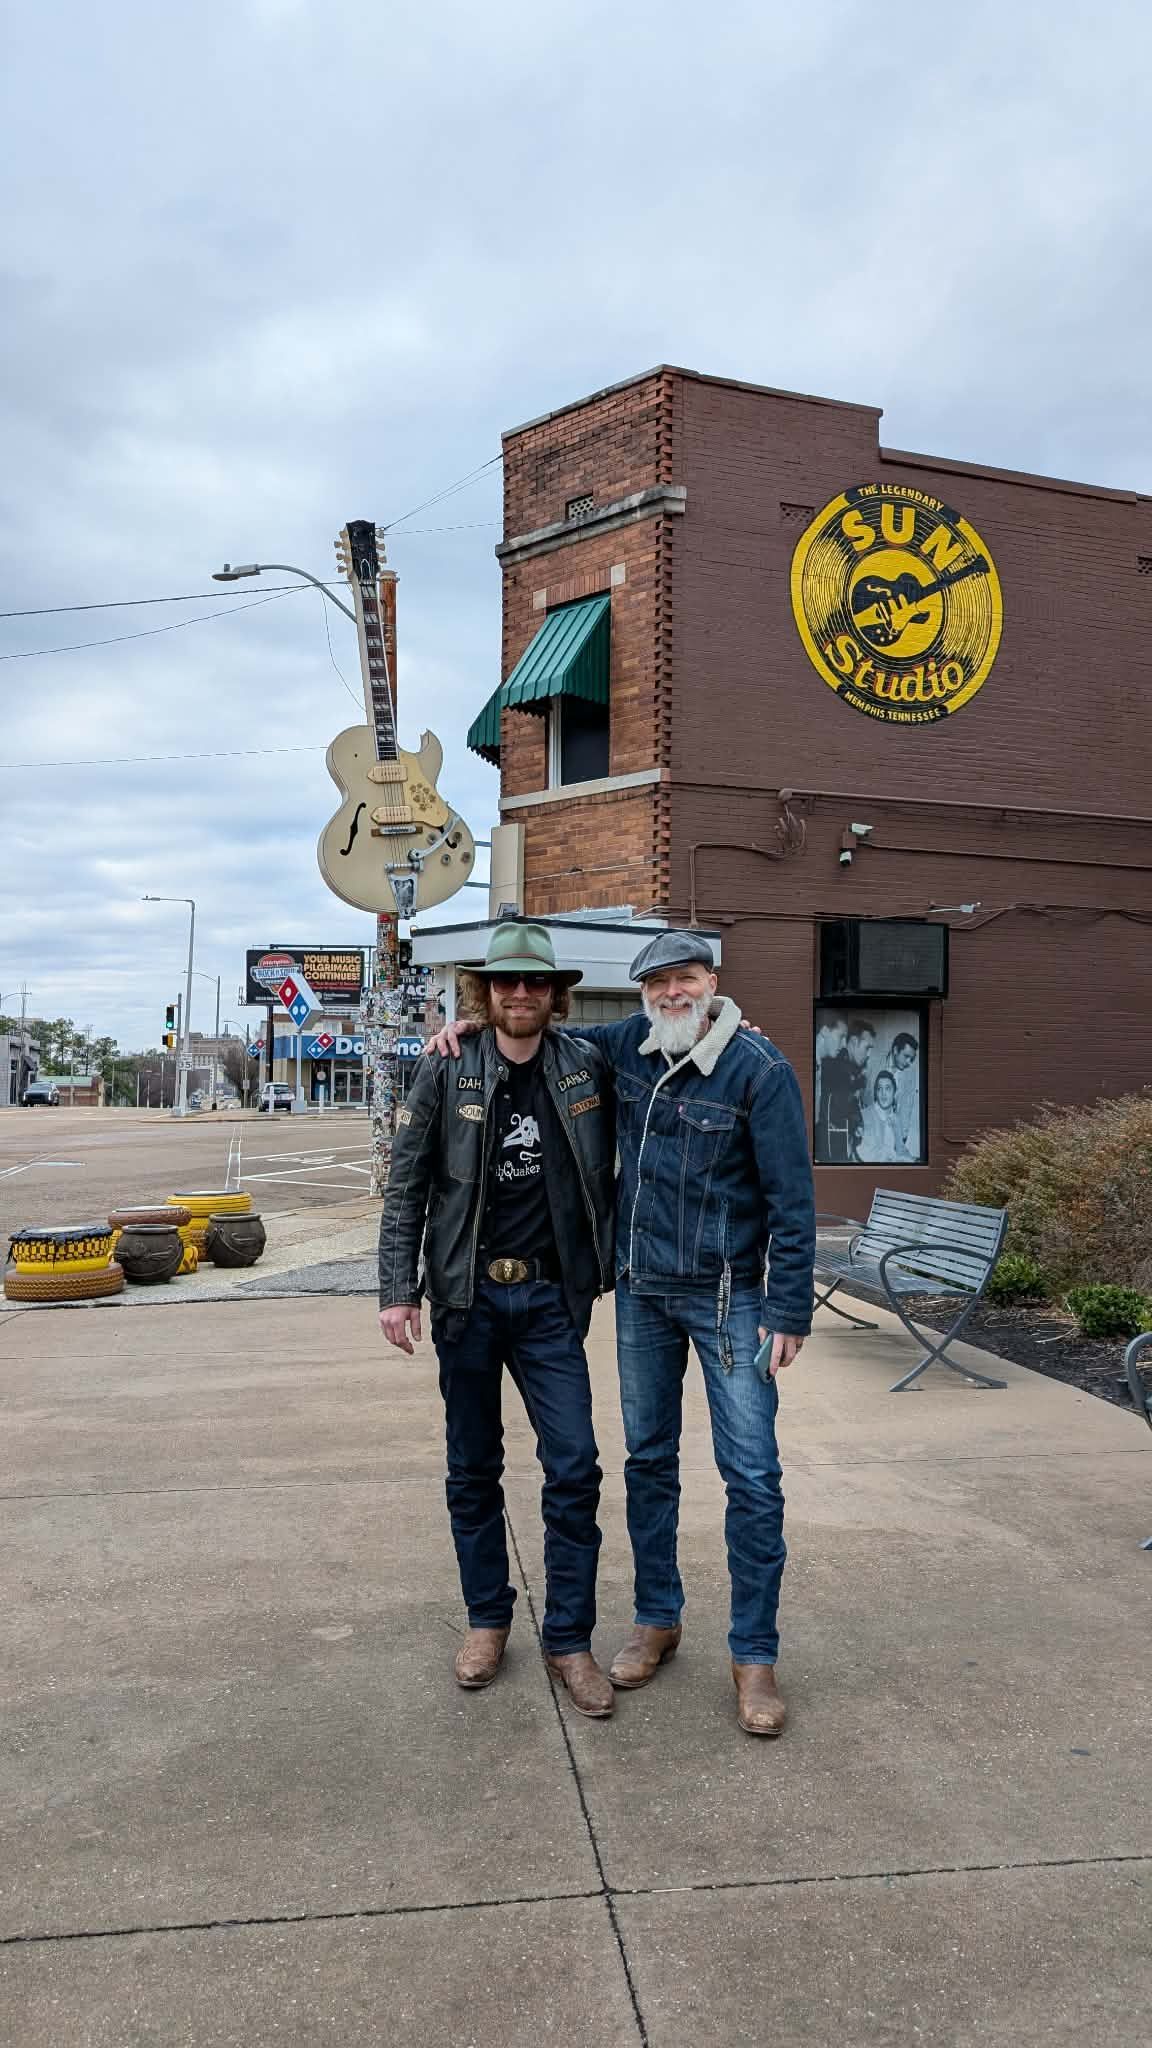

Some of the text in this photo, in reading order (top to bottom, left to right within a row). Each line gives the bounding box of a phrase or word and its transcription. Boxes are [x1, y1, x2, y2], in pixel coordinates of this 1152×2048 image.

[857, 484, 944, 511] THE LEGENDARY
[842, 503, 961, 571] SUN
[824, 633, 964, 702] Studio
[844, 691, 941, 722] MEMPHIS TENNESSEE
[303, 954, 361, 964] YOUR MUSIC
[303, 963, 361, 972] PILGRIMAGE
[304, 971, 361, 980] CONTINUES!
